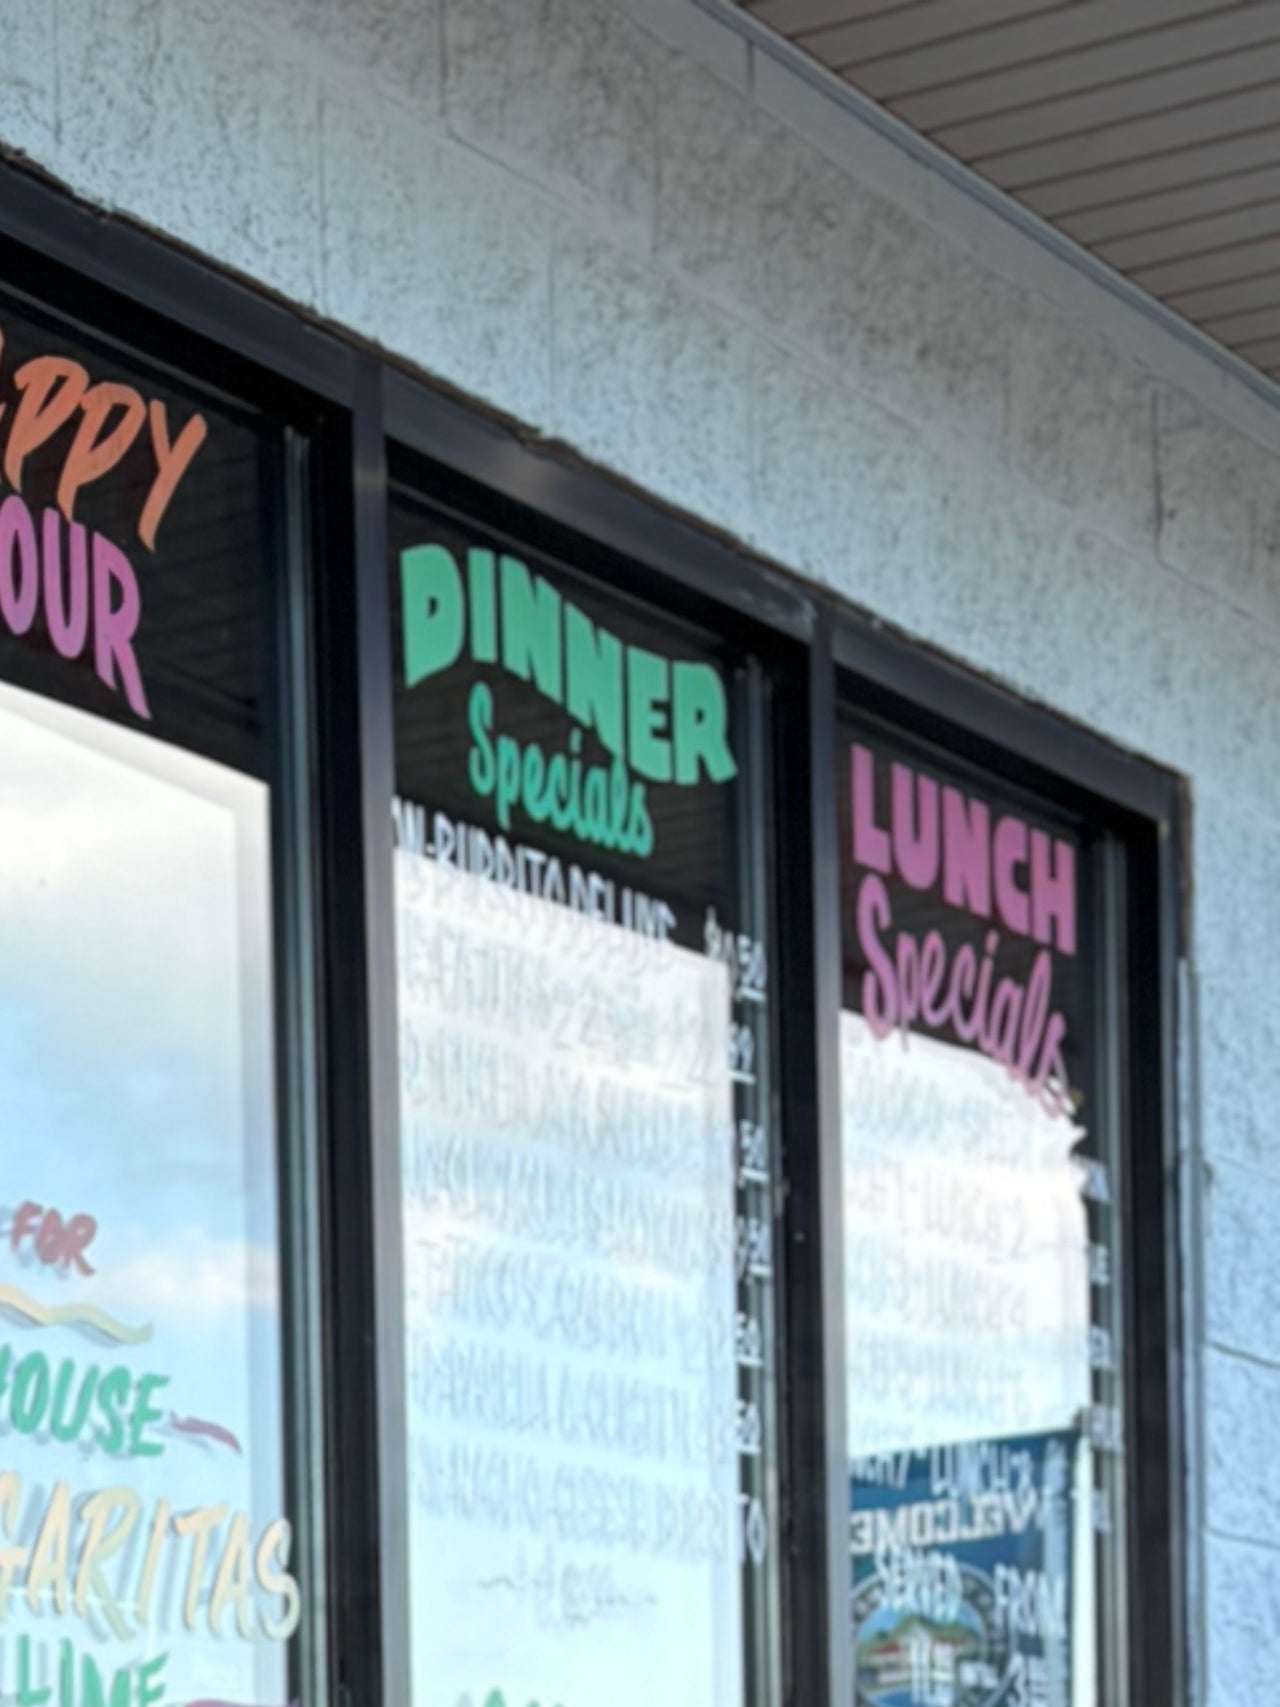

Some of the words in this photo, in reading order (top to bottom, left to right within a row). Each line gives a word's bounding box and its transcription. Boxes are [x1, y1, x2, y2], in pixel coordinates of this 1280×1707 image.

[400, 543, 738, 786] DINNER
[468, 681, 654, 858] Specials
[851, 743, 1077, 957] LUNCH
[856, 873, 1075, 1117] Specials
[10, 1200, 97, 1277] FOR
